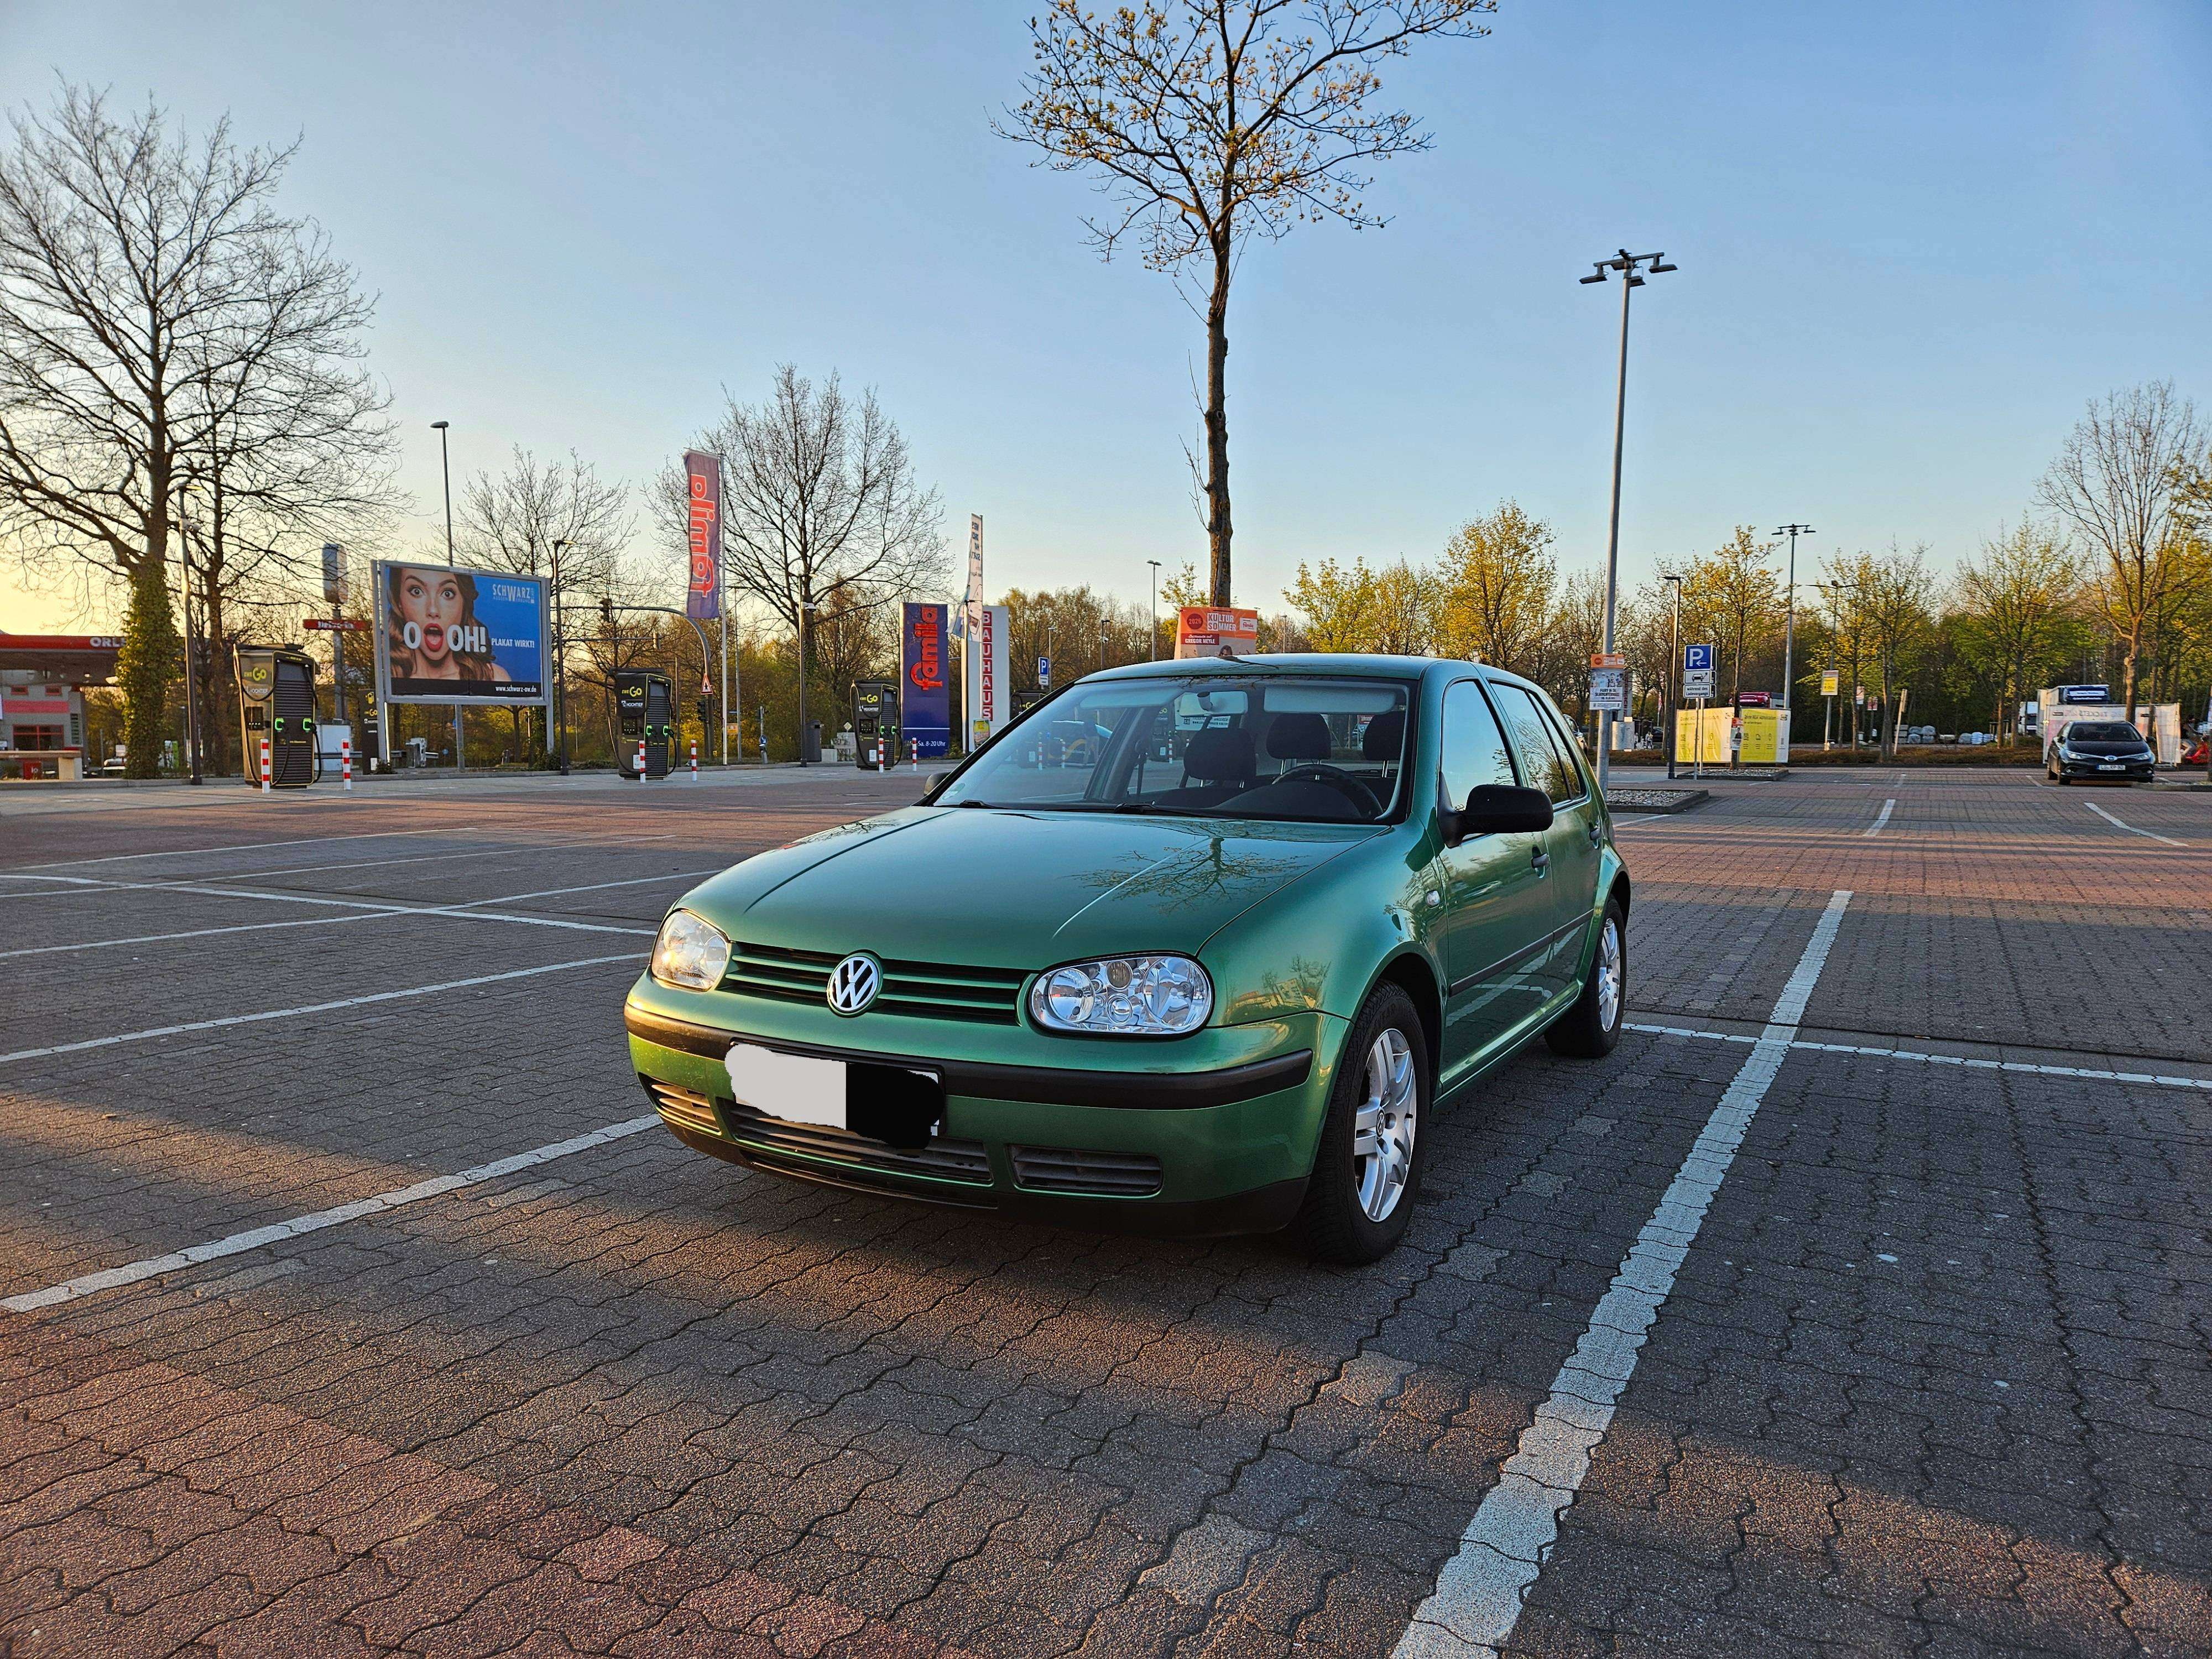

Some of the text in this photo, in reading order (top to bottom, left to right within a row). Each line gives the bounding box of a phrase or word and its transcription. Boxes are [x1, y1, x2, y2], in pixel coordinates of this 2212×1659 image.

[492, 584, 530, 602] SCHWARZ
[1208, 614, 1234, 623] KULTUR
[1208, 623, 1236, 631] SOMMER
[447, 625, 487, 653] OH!
[491, 638, 535, 648] PLAKAT WIRKT!
[911, 607, 943, 690] famila
[1689, 648, 1703, 666] P
[982, 613, 992, 718] BAUHAUS
[1041, 660, 1046, 673] P
[252, 667, 267, 681] Go
[629, 686, 642, 697] Go
[867, 694, 878, 703] Go
